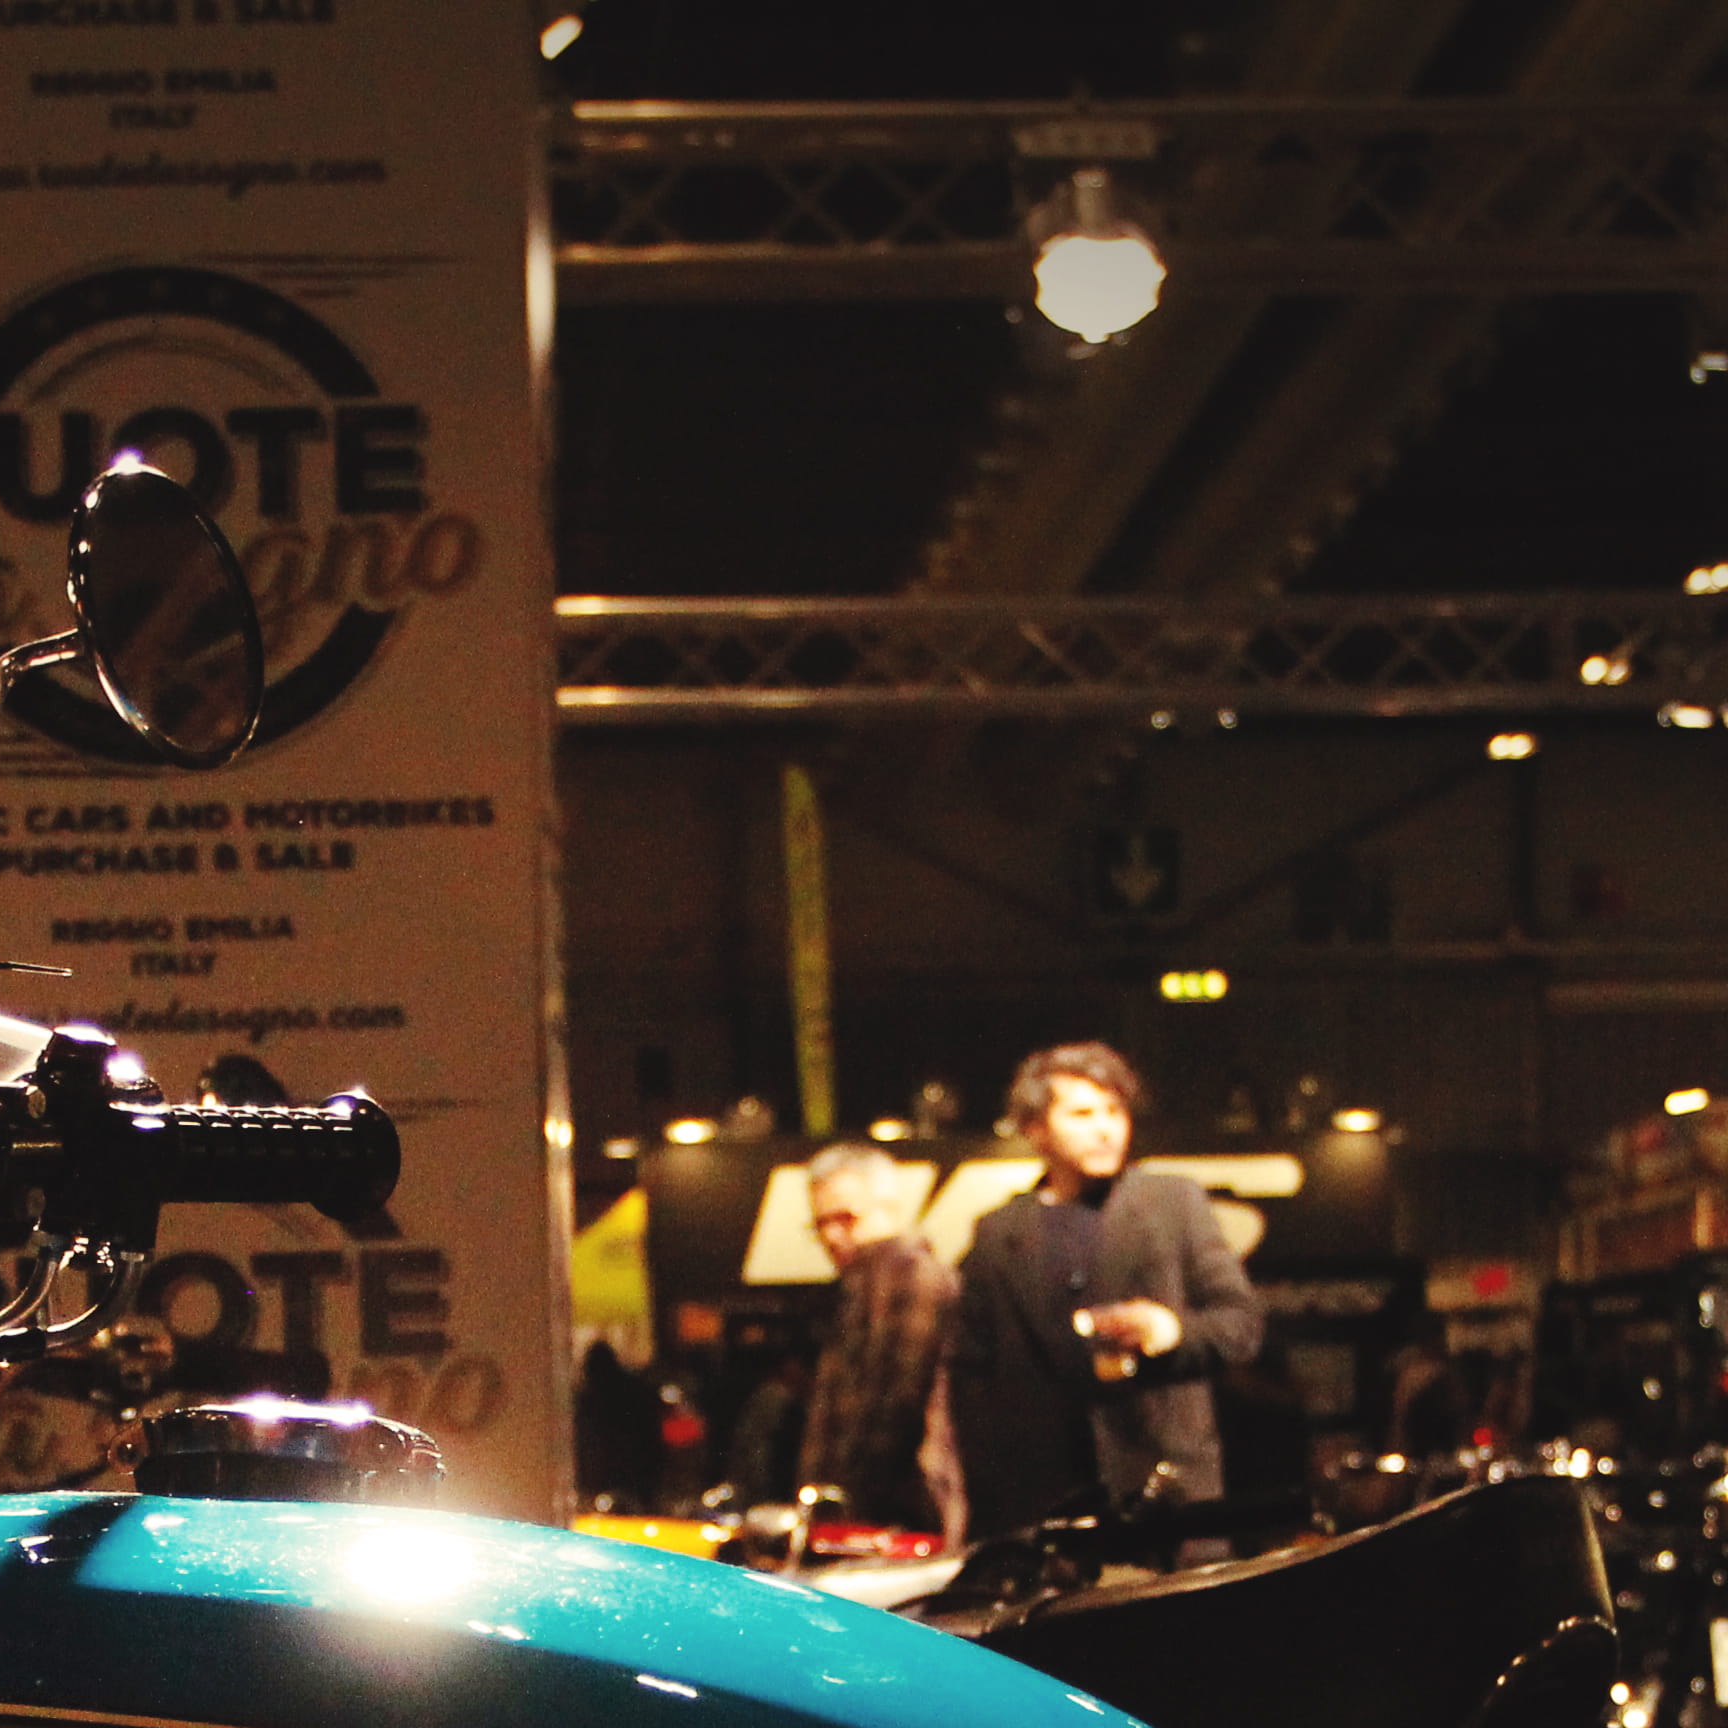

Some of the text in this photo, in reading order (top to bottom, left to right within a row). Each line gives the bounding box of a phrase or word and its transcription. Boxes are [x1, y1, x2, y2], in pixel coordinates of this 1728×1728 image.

[24, 804, 128, 834] CARS
[147, 803, 231, 831] AND
[244, 797, 494, 829] MOTORBIKES
[257, 839, 354, 872] SALE
[184, 914, 294, 941] EMILIA
[131, 952, 217, 977] ITALY
